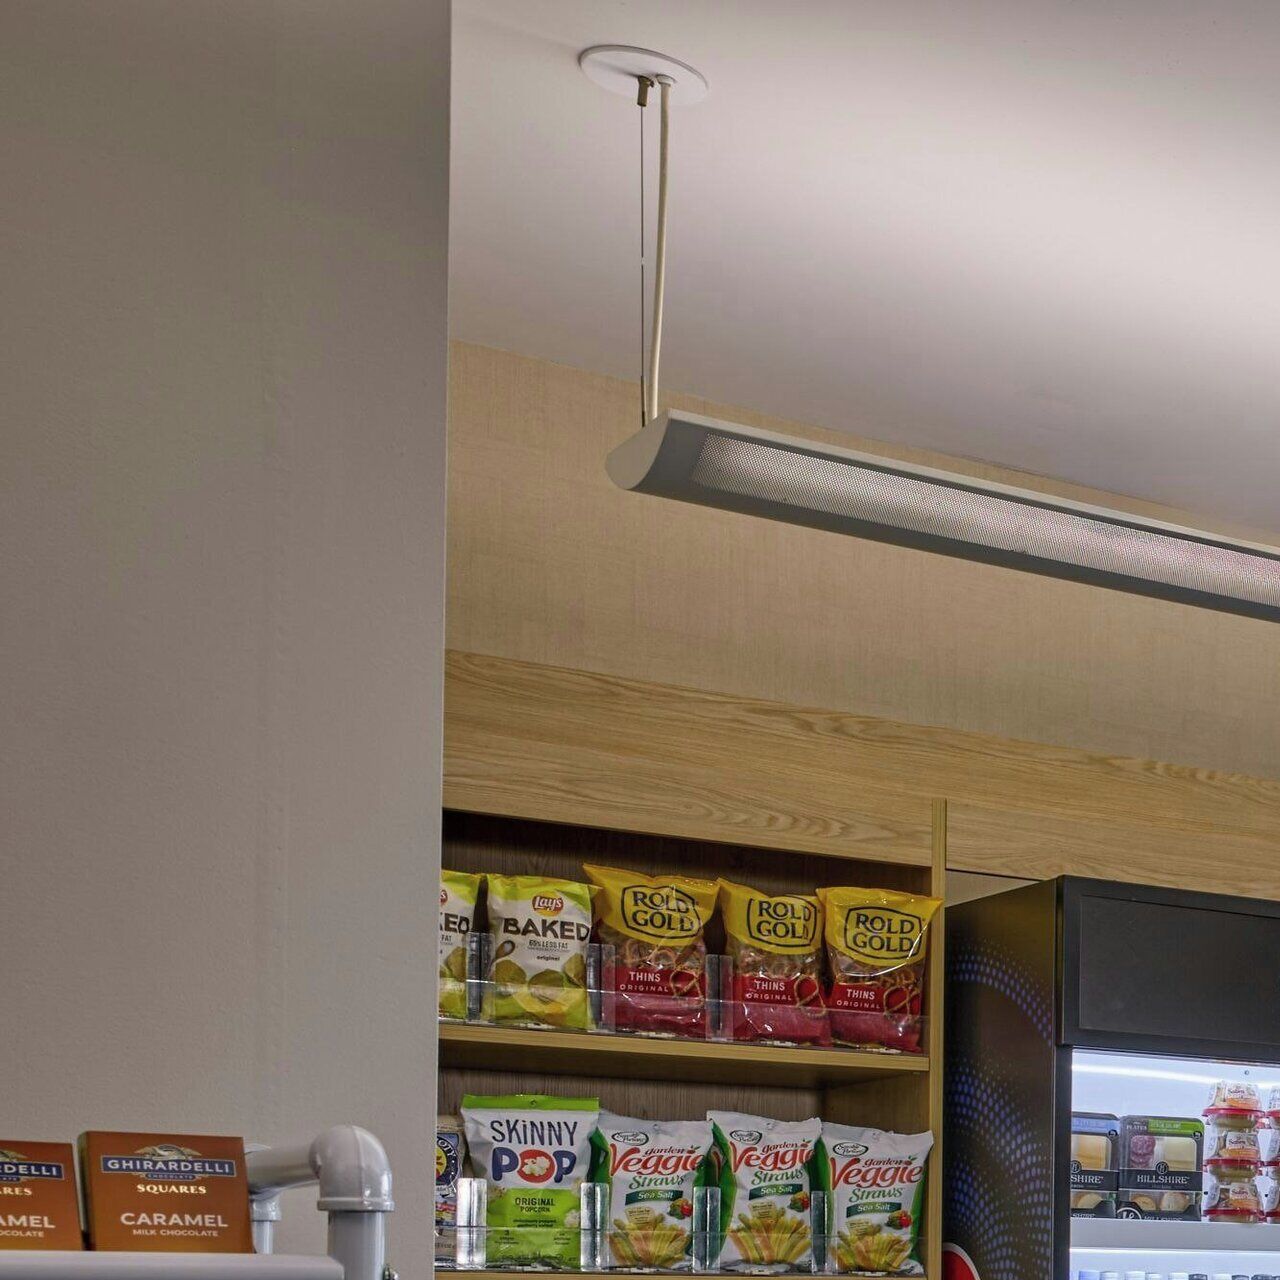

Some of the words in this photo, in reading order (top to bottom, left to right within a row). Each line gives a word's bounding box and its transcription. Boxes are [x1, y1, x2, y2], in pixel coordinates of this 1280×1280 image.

[534, 895, 562, 909] Lay's
[632, 890, 689, 914] ROLD
[758, 901, 810, 922] ROLD
[632, 910, 694, 932] GOLD
[855, 913, 914, 934] ROLD
[503, 918, 590, 941] BAKED
[853, 934, 913, 953] GOLD
[629, 971, 661, 982] THINS
[620, 984, 668, 993] ORIGINAL
[755, 981, 785, 991] THINS
[846, 989, 875, 1000] THINS
[762, 1141, 799, 1153] garden
[107, 1159, 230, 1173] GHIRARDELLI
[491, 1147, 576, 1183] POP
[829, 1158, 923, 1191] Veggie
[1137, 1175, 1189, 1183] HILLSHIRE
[137, 1184, 207, 1194] SQUARES
[638, 1191, 656, 1200] Sea
[657, 1191, 674, 1199] Salt
[849, 1188, 903, 1203] Straws
[514, 1197, 555, 1206] ORIGINAL
[858, 1203, 873, 1212] Sea
[874, 1203, 890, 1211] Salt
[120, 1213, 228, 1227] CARAMEL
